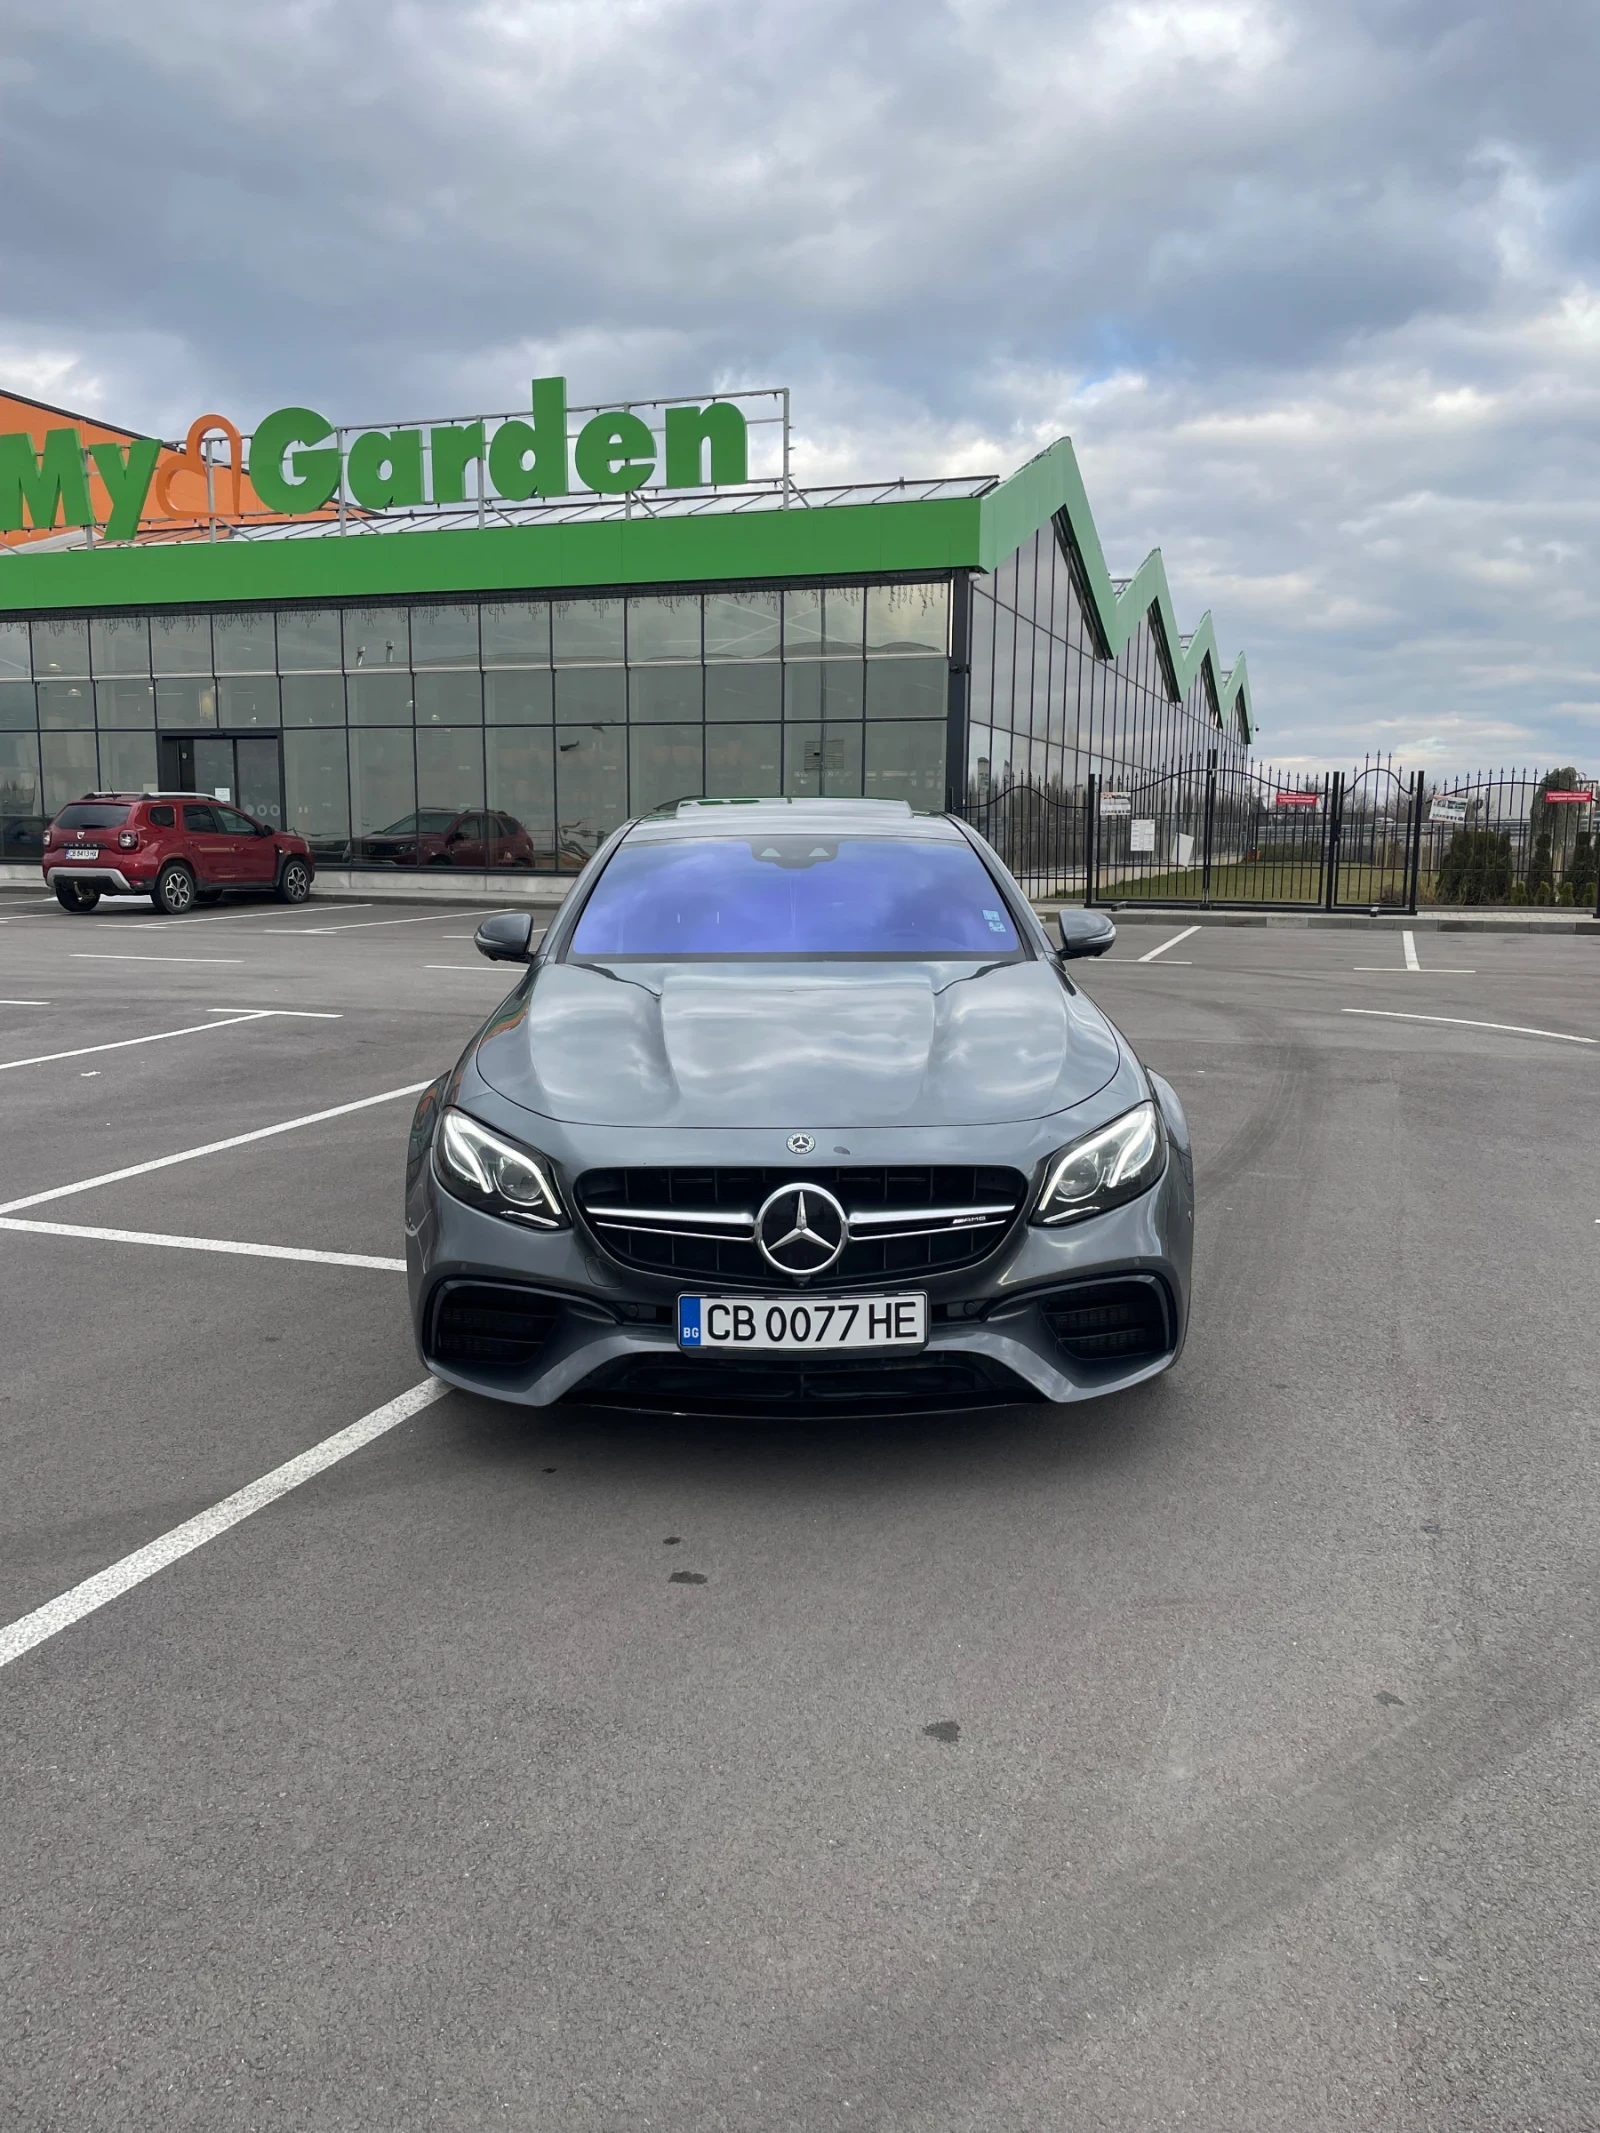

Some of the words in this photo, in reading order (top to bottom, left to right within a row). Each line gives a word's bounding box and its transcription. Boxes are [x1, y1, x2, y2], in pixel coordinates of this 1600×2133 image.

[0, 427, 163, 540] My
[249, 376, 748, 514] Garden
[683, 1327, 700, 1338] BG
[707, 1304, 756, 1341] CB
[765, 1304, 860, 1342] 0077
[868, 1301, 917, 1340] HE
